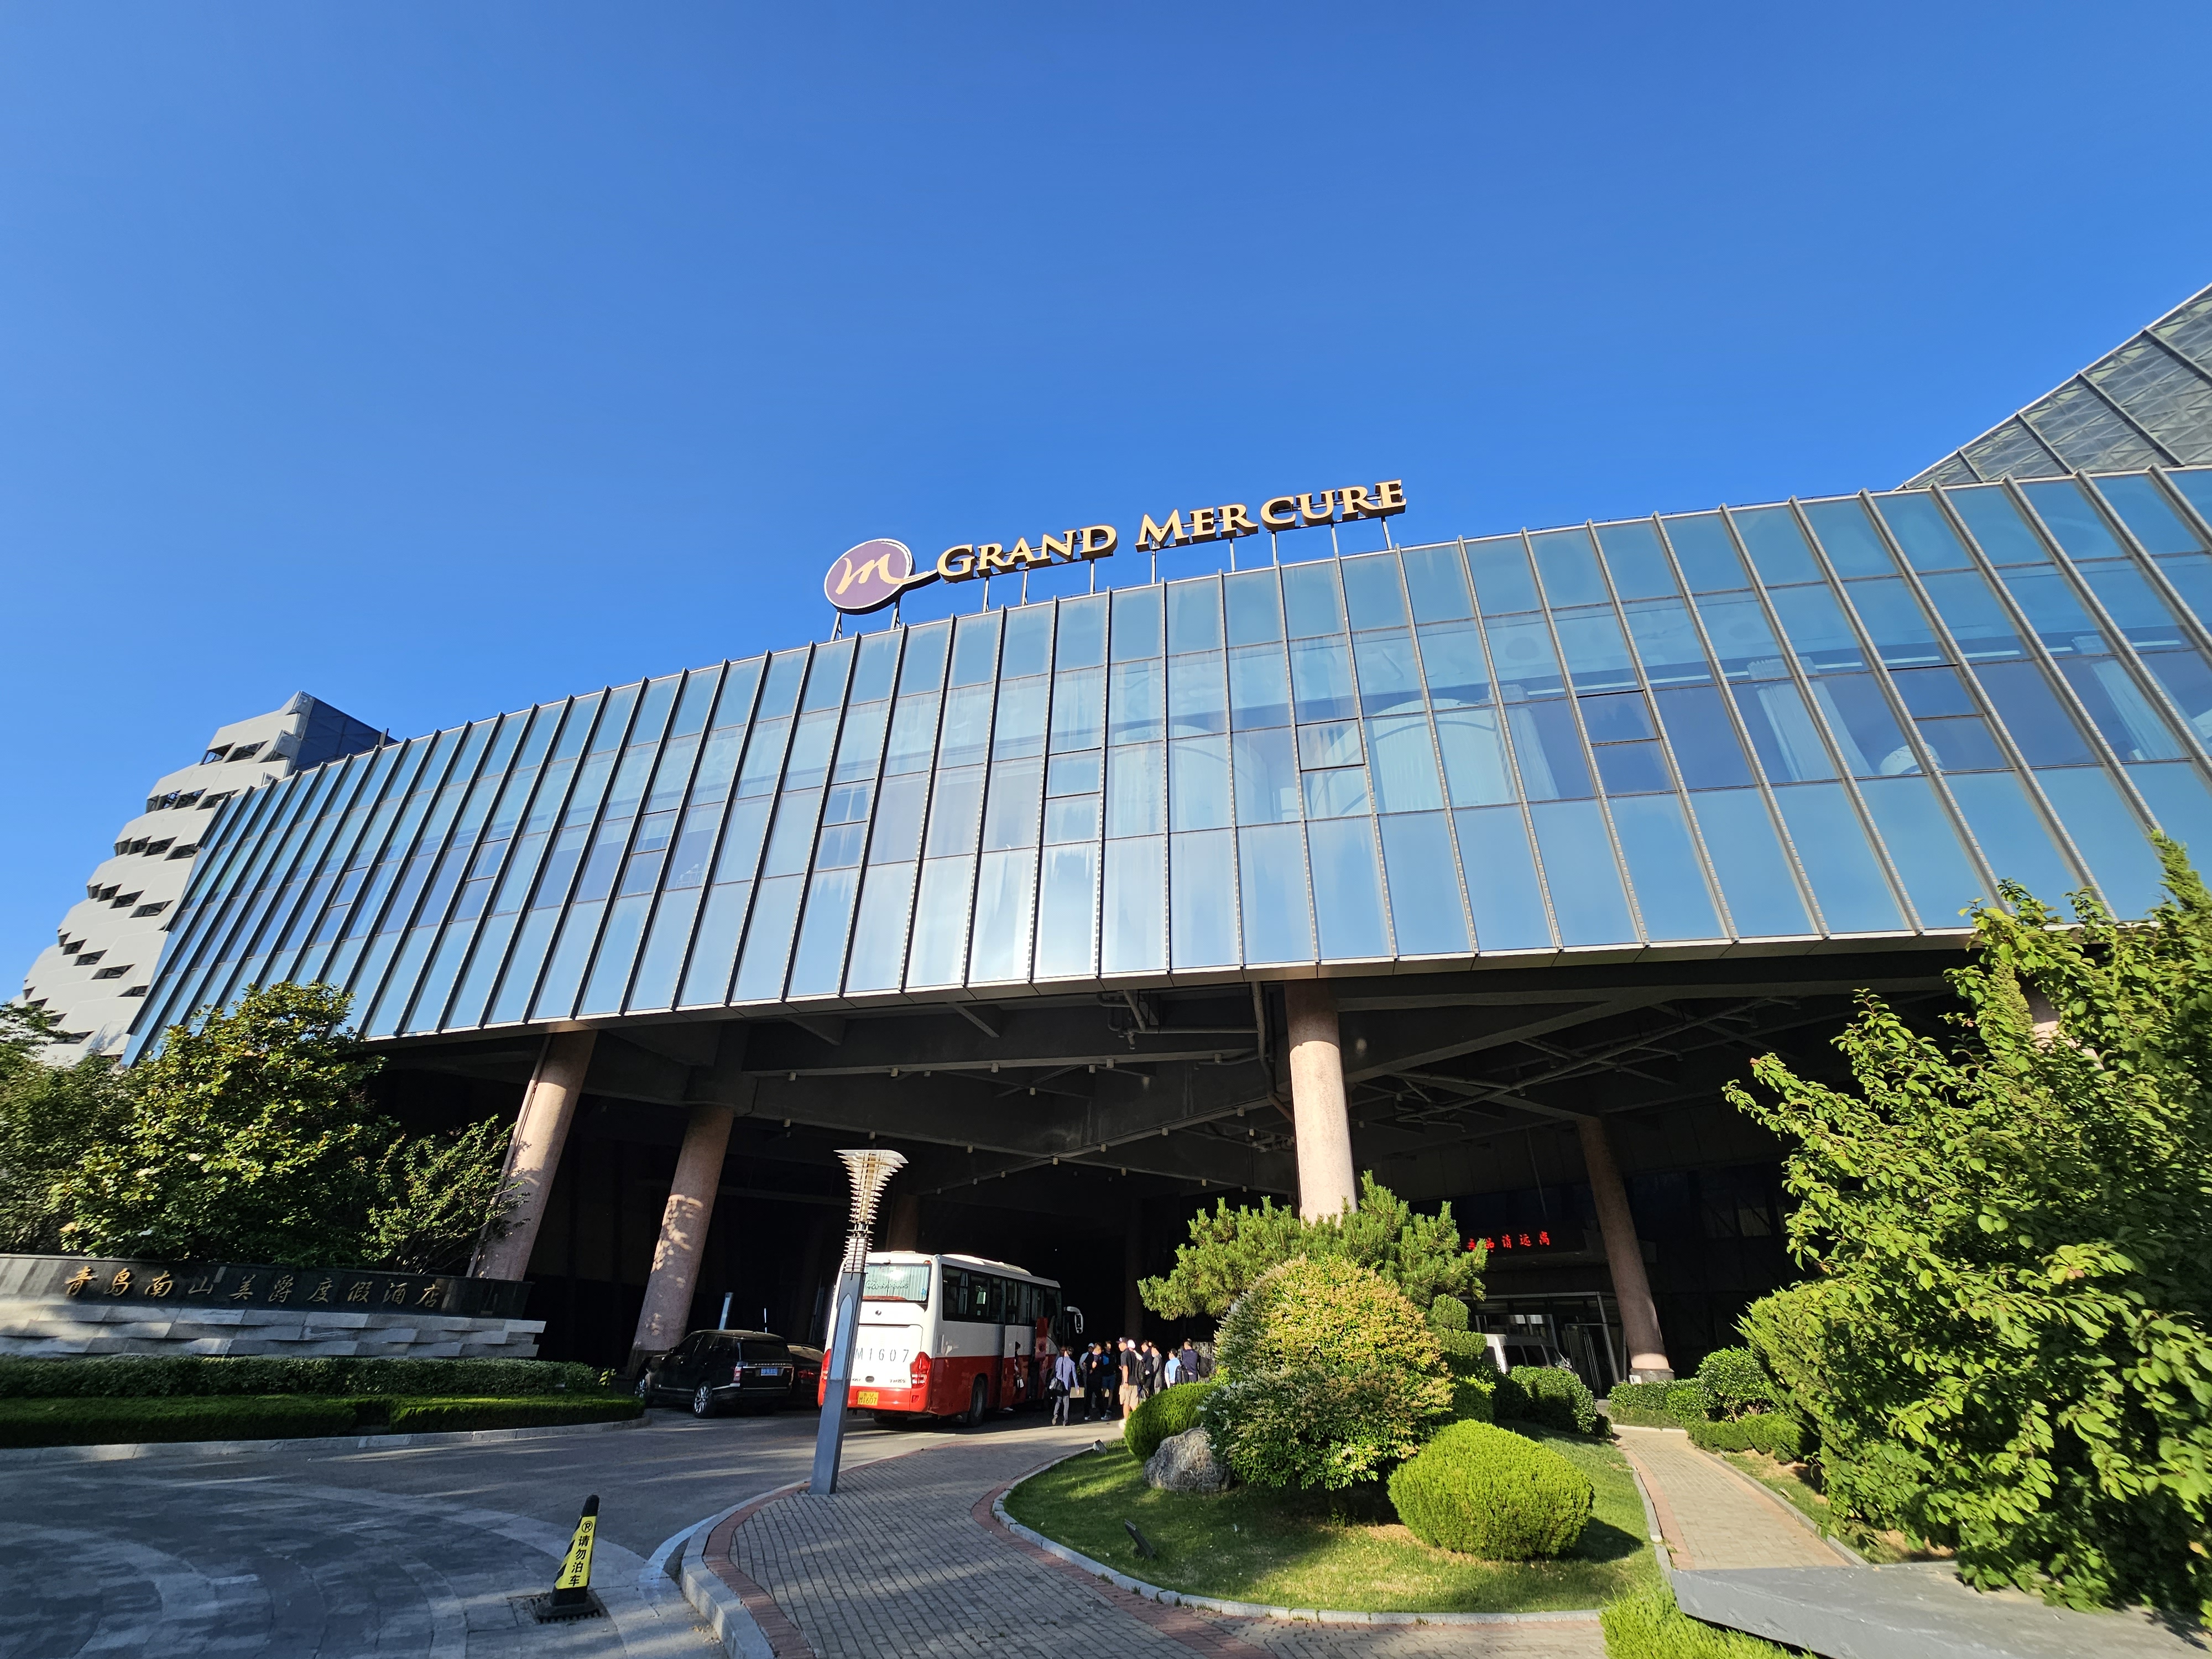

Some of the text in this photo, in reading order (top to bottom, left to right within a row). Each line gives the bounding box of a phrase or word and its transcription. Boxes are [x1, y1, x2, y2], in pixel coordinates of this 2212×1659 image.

[937, 479, 1407, 579] GRAND MERCURE
[64, 1265, 441, 1308] 青岛南山美爵度假酒店
[568, 1535, 590, 1587] 请勿泊车
